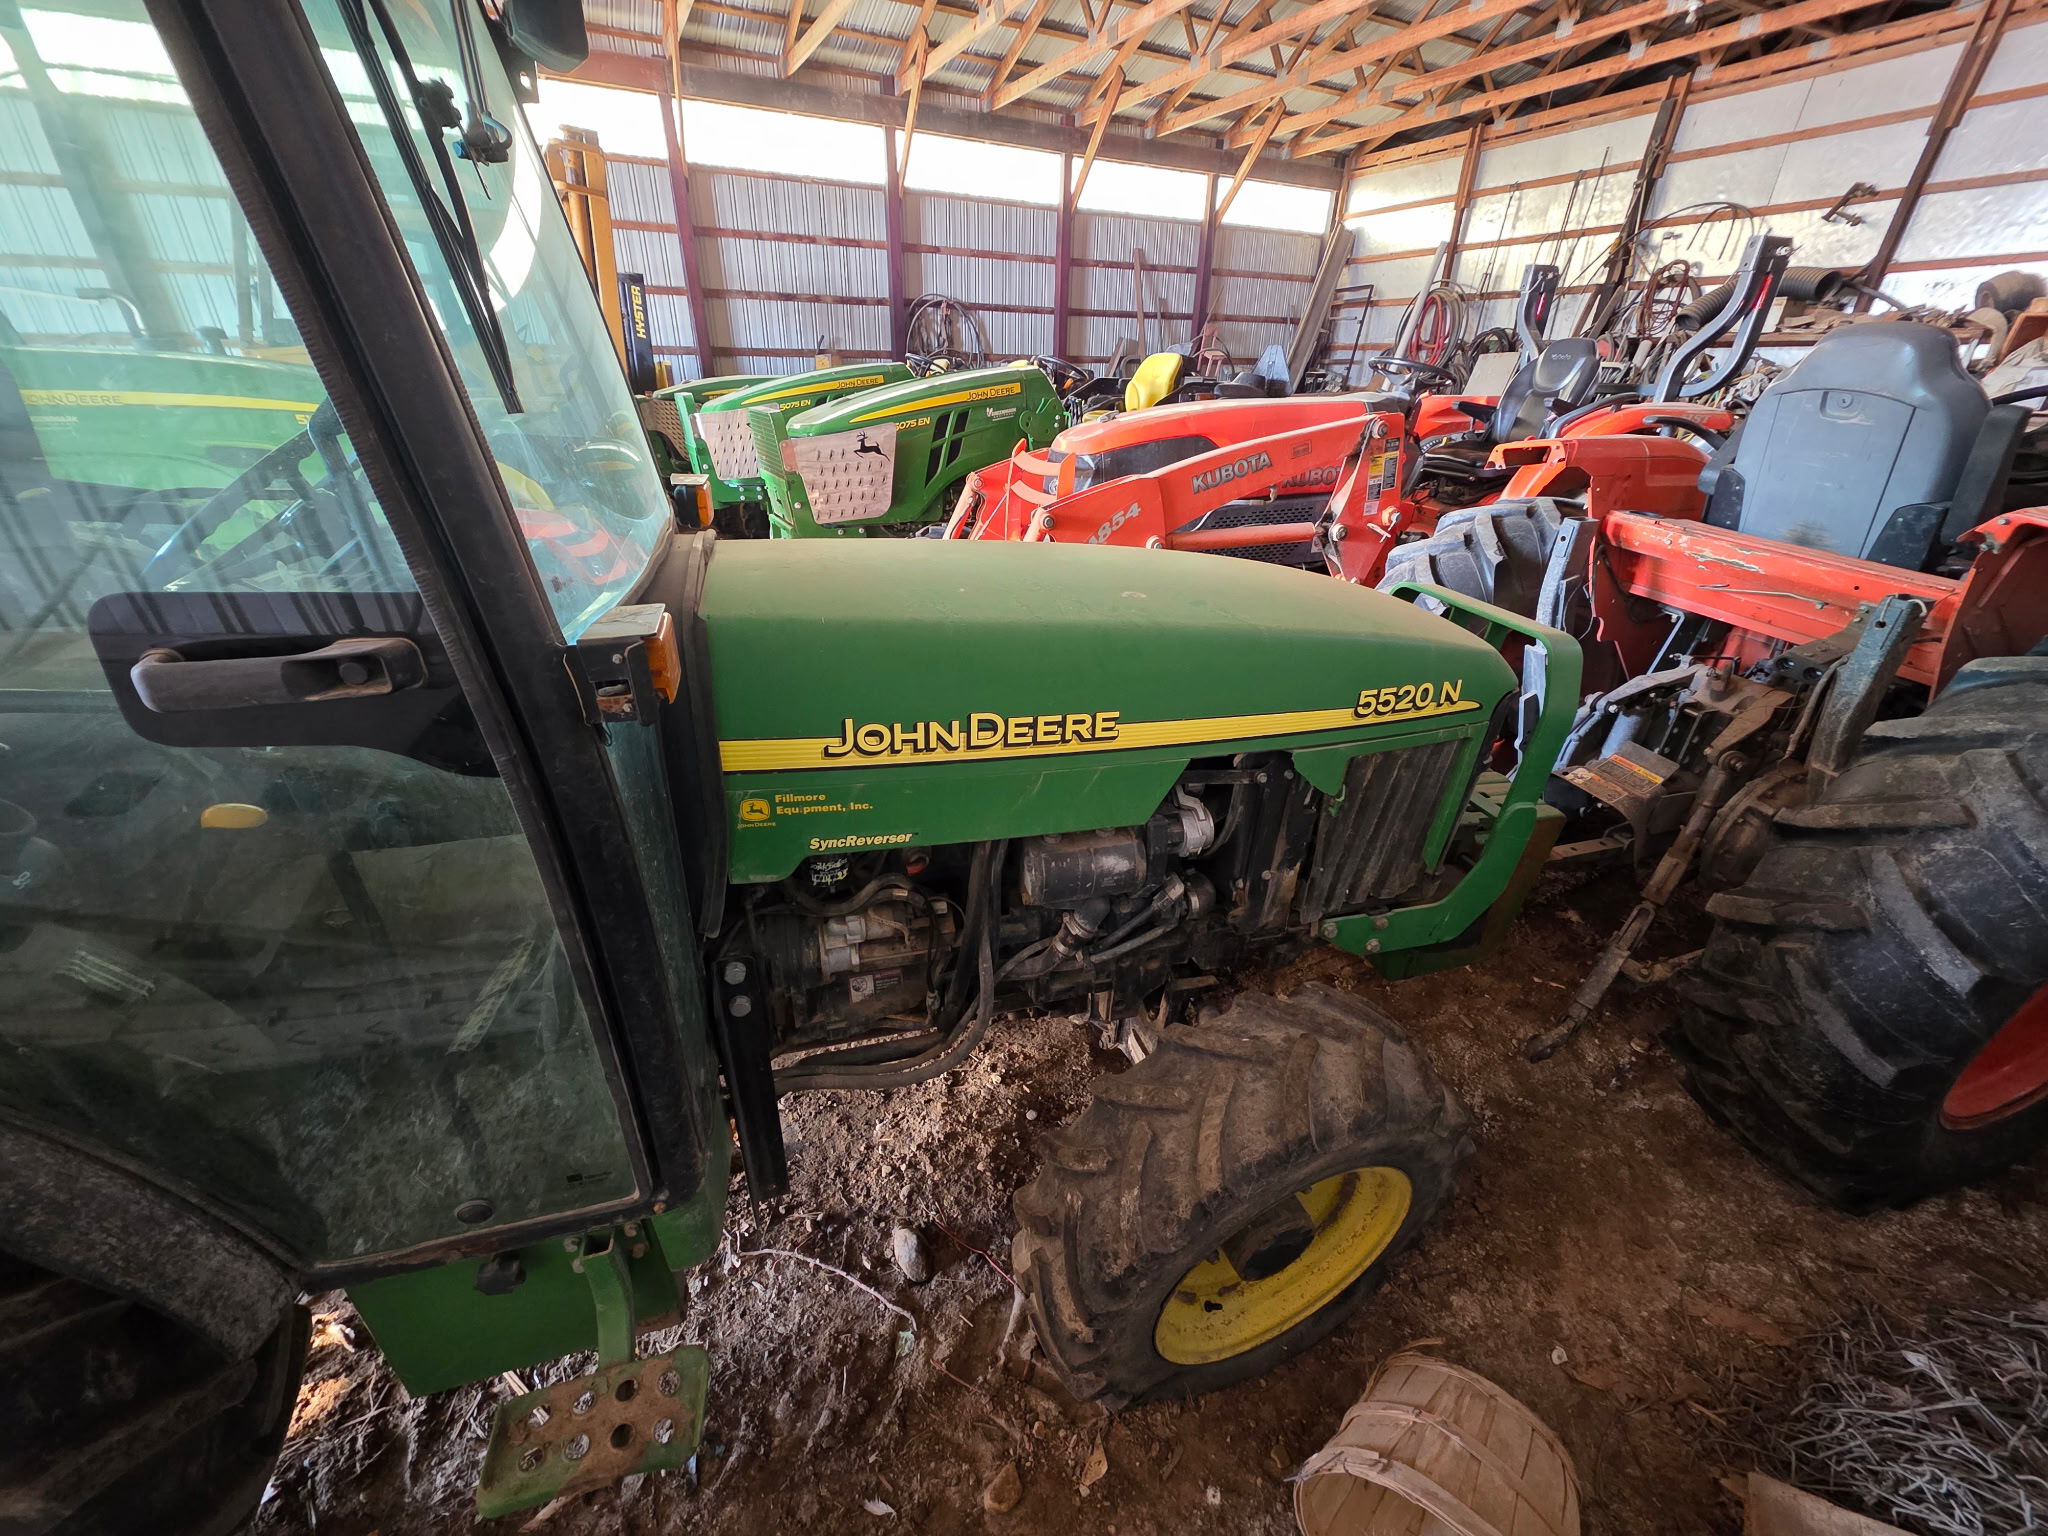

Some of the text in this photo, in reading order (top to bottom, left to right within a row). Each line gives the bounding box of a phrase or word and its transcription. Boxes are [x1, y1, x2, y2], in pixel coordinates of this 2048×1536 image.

[630, 285, 646, 339] HYSTER
[856, 378, 879, 386] DEERE
[27, 392, 123, 407] OHN DEERE
[967, 387, 1015, 401] JOHN DEERE
[780, 399, 811, 411] 5075 EN
[918, 417, 931, 427] EN
[1191, 451, 1272, 494] KUBOTA
[1282, 466, 1341, 489] KUBO
[1354, 679, 1463, 718] 5520 N
[822, 711, 1120, 758] JOHN DEERE
[775, 794, 826, 803] Fillmore
[850, 802, 873, 811] Inc.
[809, 832, 912, 852] SyncReverser
